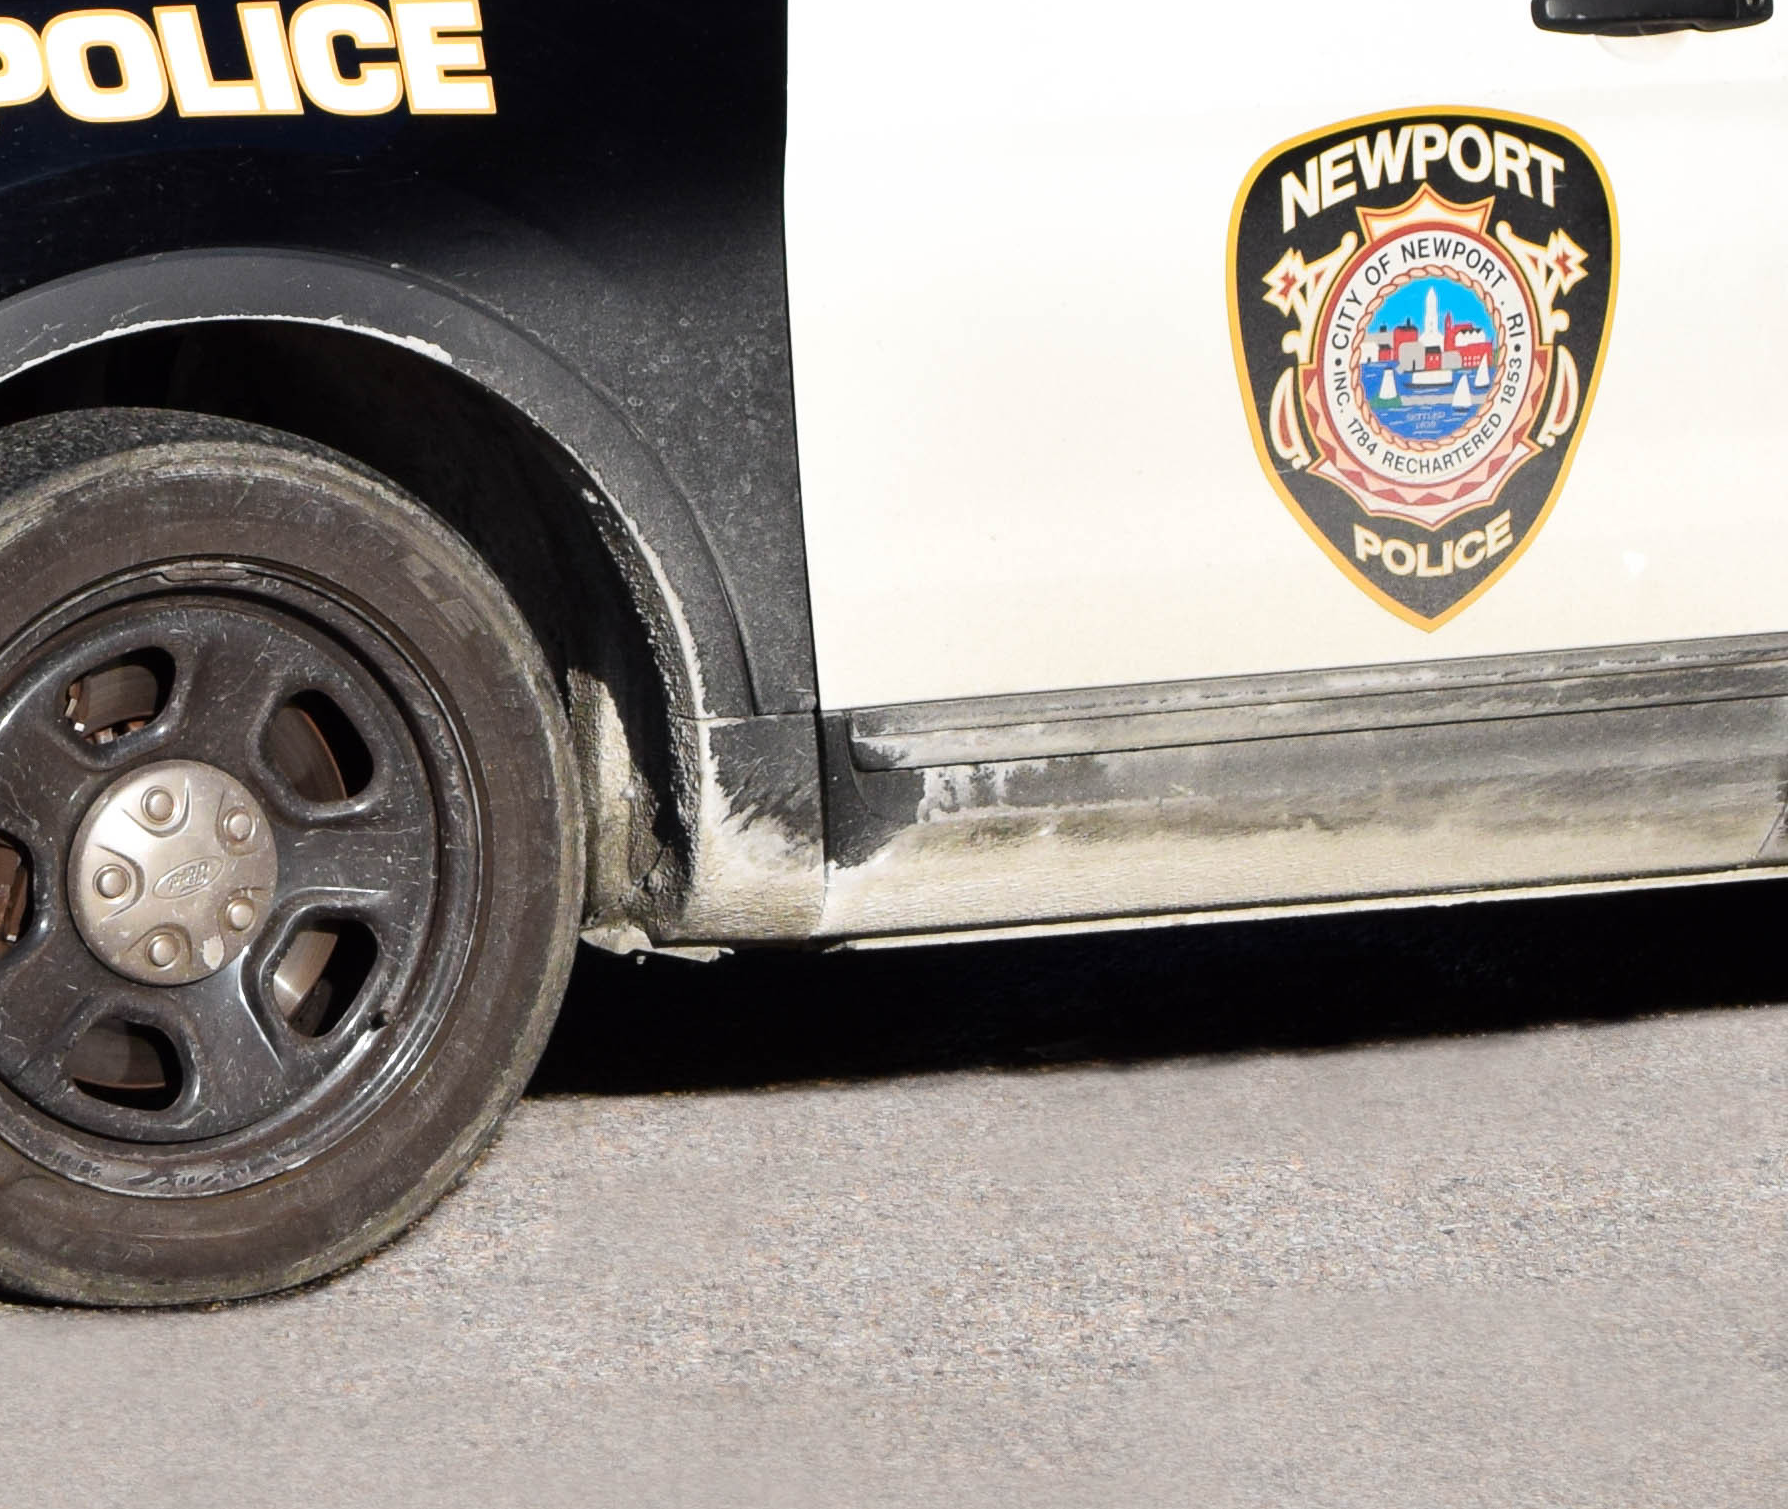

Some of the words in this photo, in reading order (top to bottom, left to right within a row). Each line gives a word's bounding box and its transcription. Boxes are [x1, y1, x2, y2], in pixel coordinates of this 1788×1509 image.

[1280, 124, 1565, 234] NEWPORT
[1331, 289, 1363, 350] CITY
[1364, 253, 1391, 286] OF
[1401, 237, 1507, 288] NEWPORT
[1506, 312, 1525, 338] RI
[1347, 418, 1378, 456] 1784
[1381, 413, 1502, 474] RECHARTERED
[1500, 358, 1522, 404] 1853
[1352, 510, 1513, 578] POLICE
